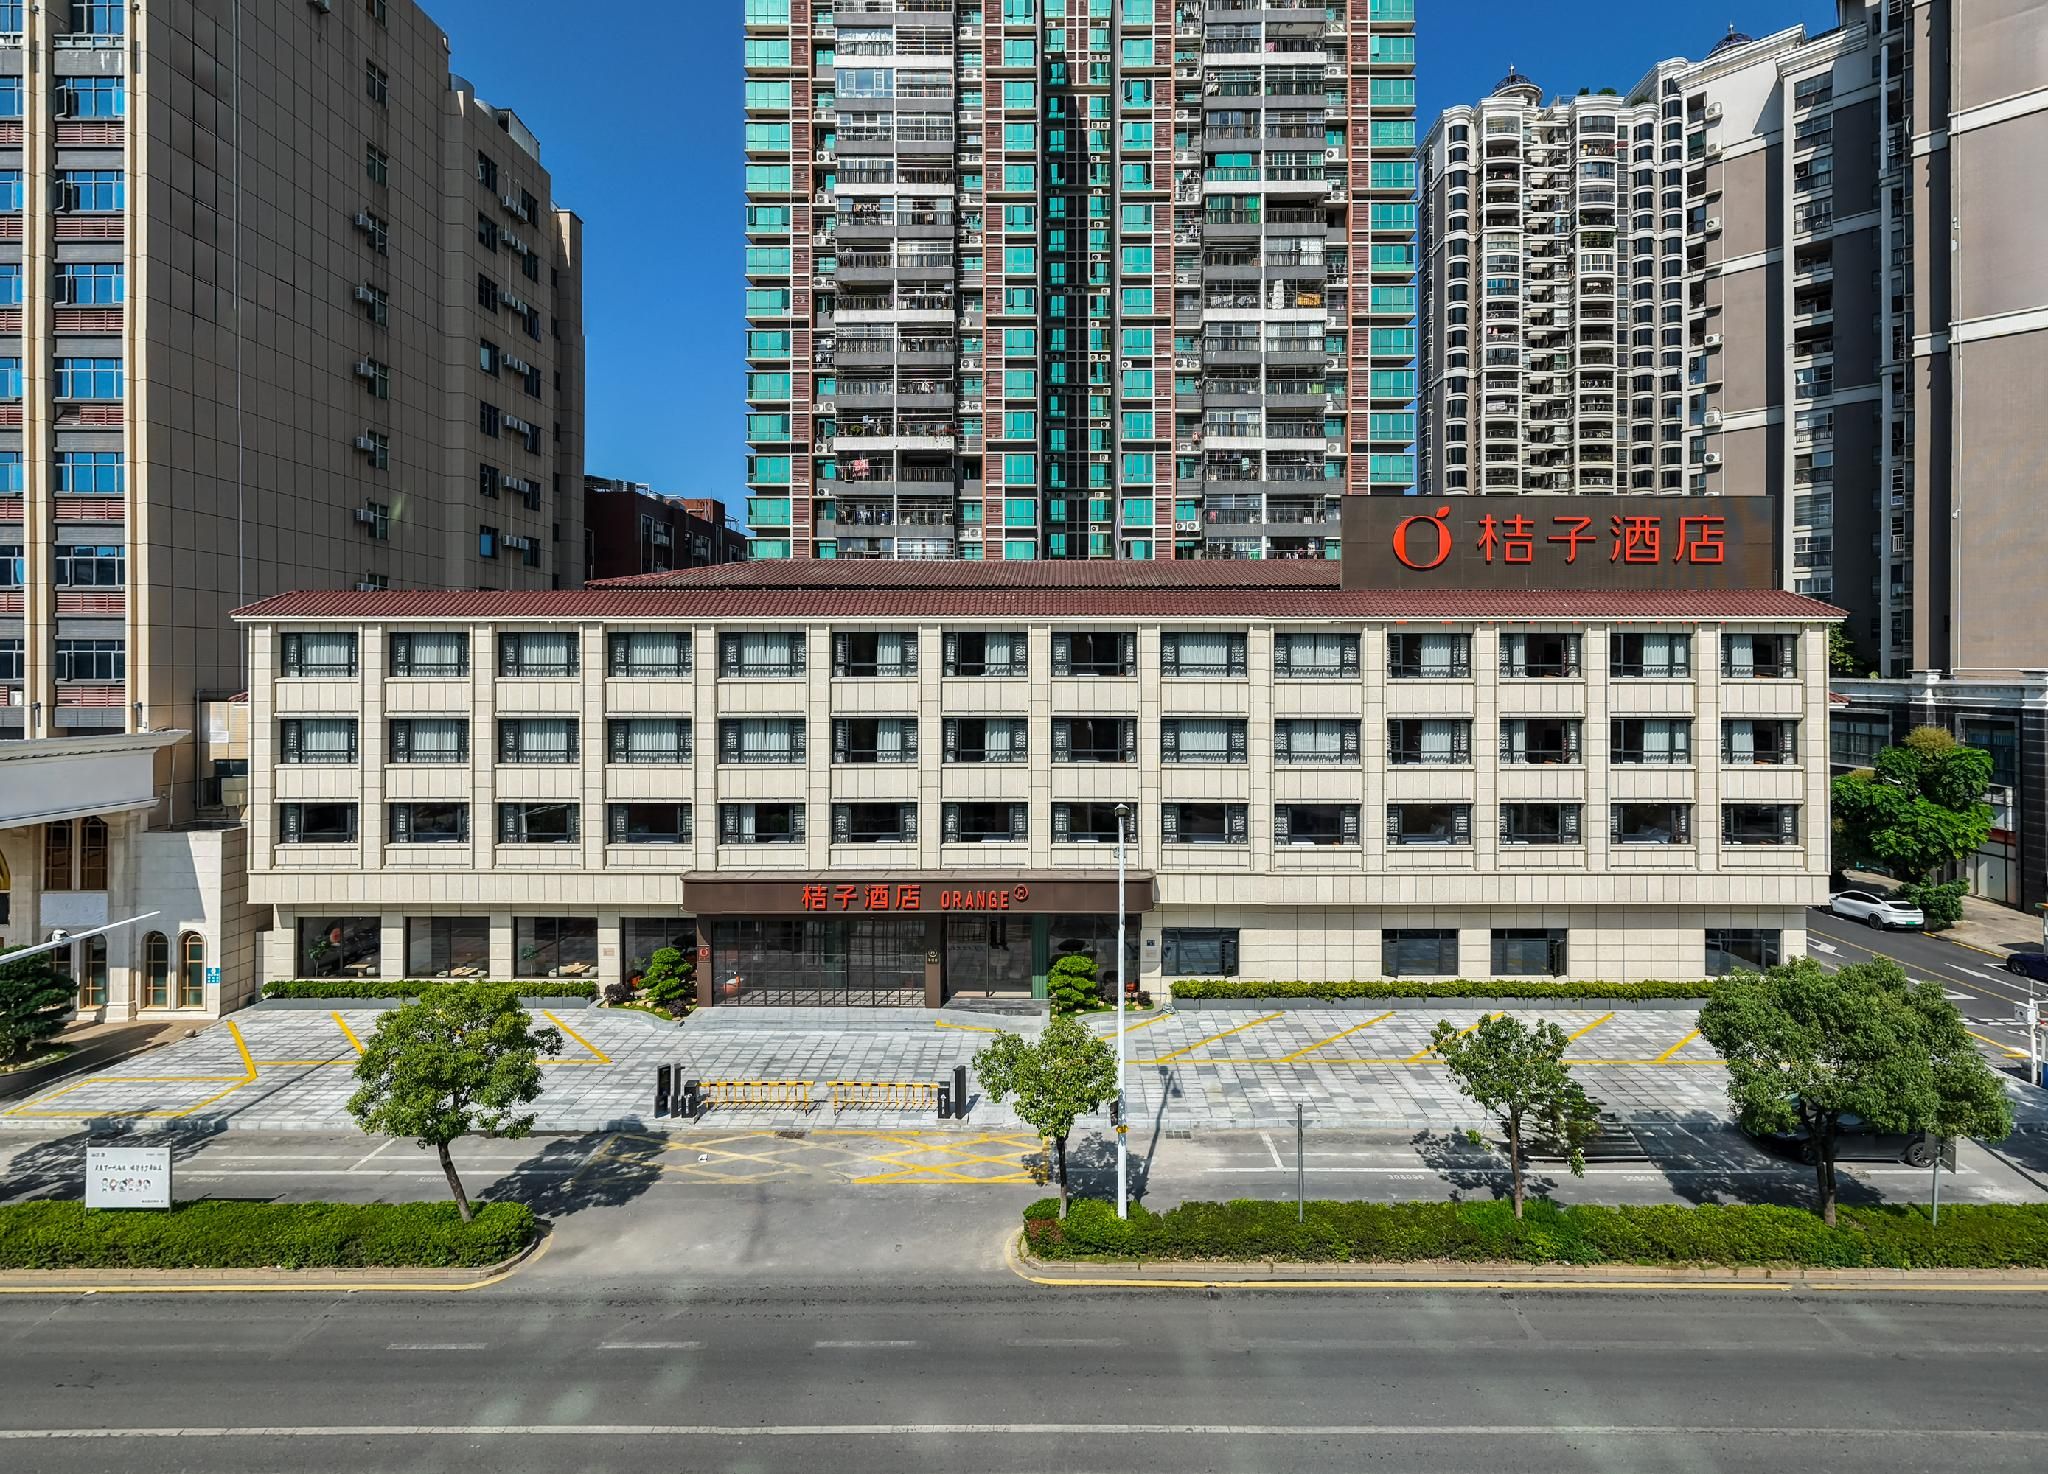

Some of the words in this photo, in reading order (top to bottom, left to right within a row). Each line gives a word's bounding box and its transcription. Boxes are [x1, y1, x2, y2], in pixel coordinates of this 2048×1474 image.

[1478, 513, 1725, 562] 桔子酒店
[801, 884, 920, 909] 桔子酒店
[941, 890, 1009, 908] ORANGE
